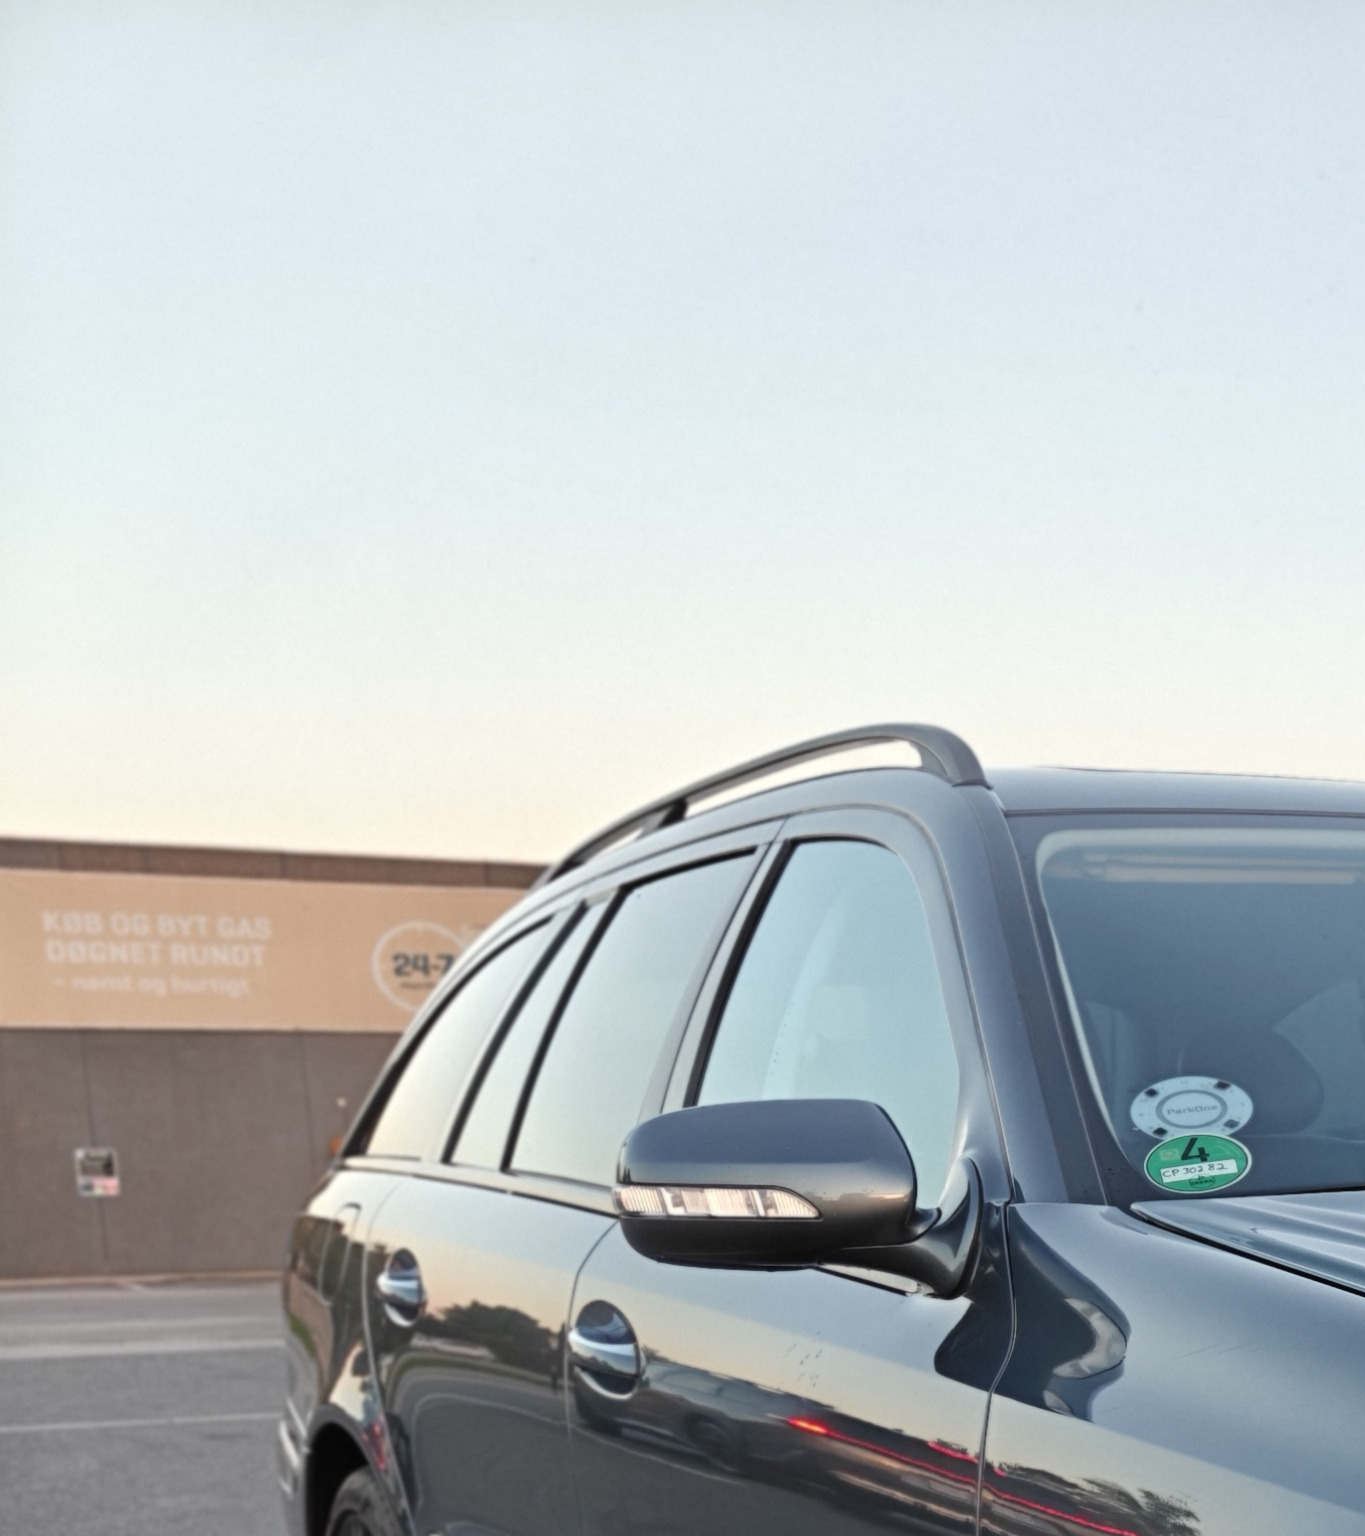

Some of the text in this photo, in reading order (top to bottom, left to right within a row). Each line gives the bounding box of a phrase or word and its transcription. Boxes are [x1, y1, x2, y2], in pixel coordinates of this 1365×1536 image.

[110, 912, 150, 936] OG
[157, 914, 208, 937] BYT
[217, 915, 271, 939] GAS
[1167, 1105, 1218, 1116] ParkOne
[1181, 1137, 1210, 1162] 4
[1162, 1168, 1180, 1178] CP
